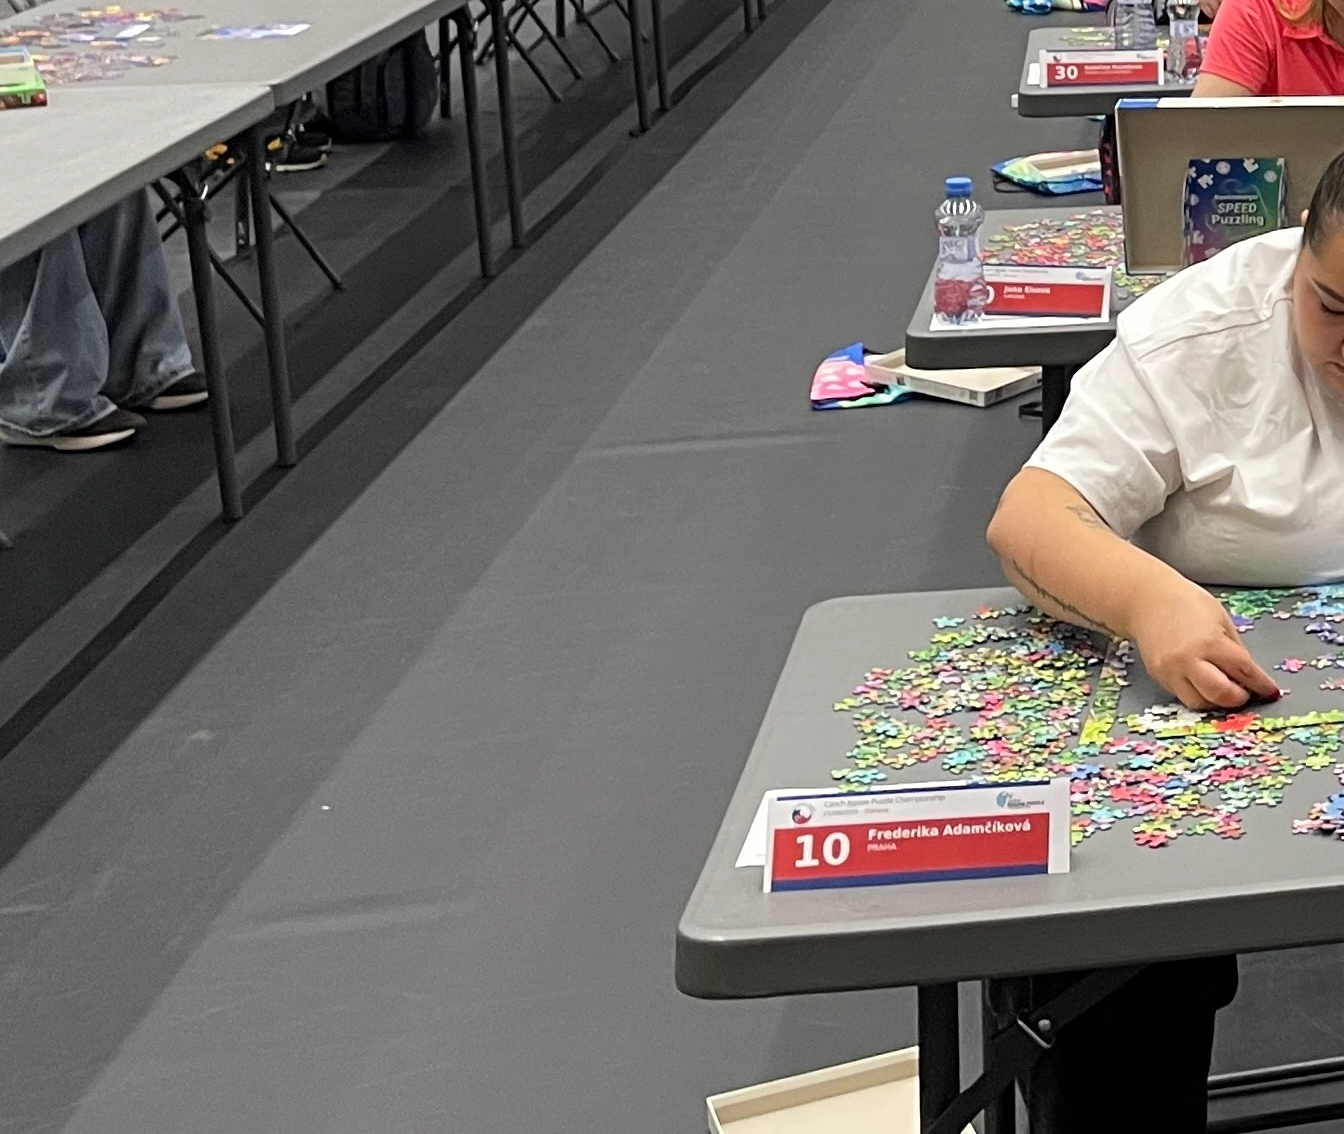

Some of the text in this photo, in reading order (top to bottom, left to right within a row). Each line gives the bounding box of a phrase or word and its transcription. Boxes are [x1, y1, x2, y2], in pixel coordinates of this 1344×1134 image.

[1054, 65, 1079, 80] 30
[1217, 202, 1257, 214] SPEED
[1211, 214, 1265, 226] Puzzling
[868, 818, 1031, 841] Frederika Adamčíková
[794, 831, 851, 868] 10
